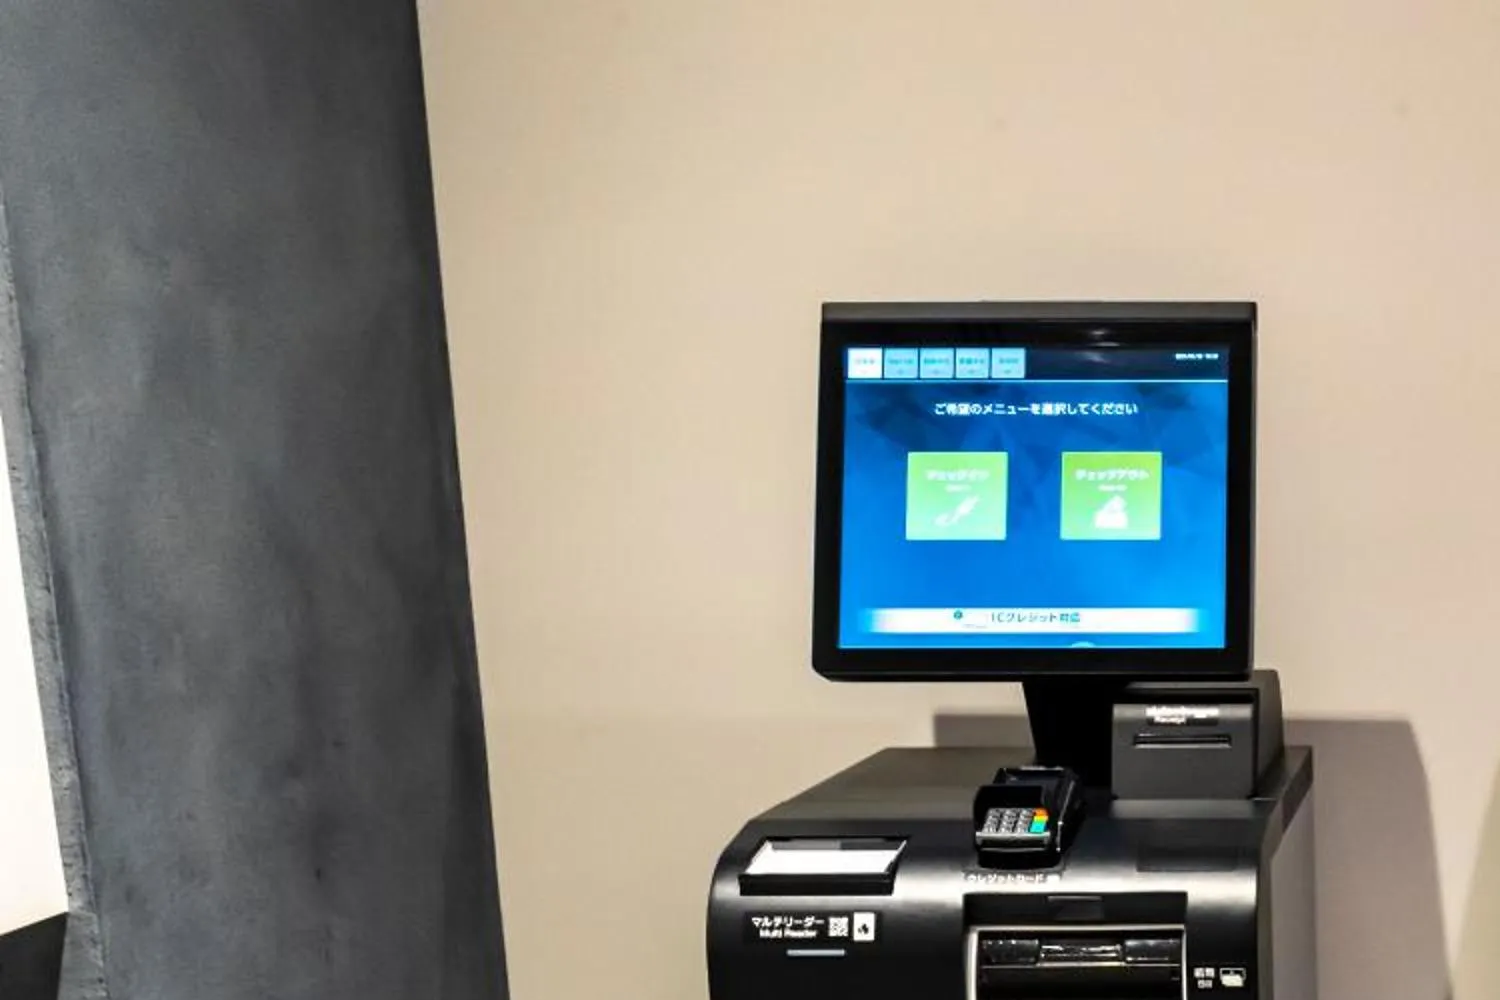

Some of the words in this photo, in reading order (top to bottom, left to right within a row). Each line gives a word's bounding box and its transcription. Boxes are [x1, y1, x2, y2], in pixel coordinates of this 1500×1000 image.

[934, 402, 1139, 416] ご希望のメニューを選択してください
